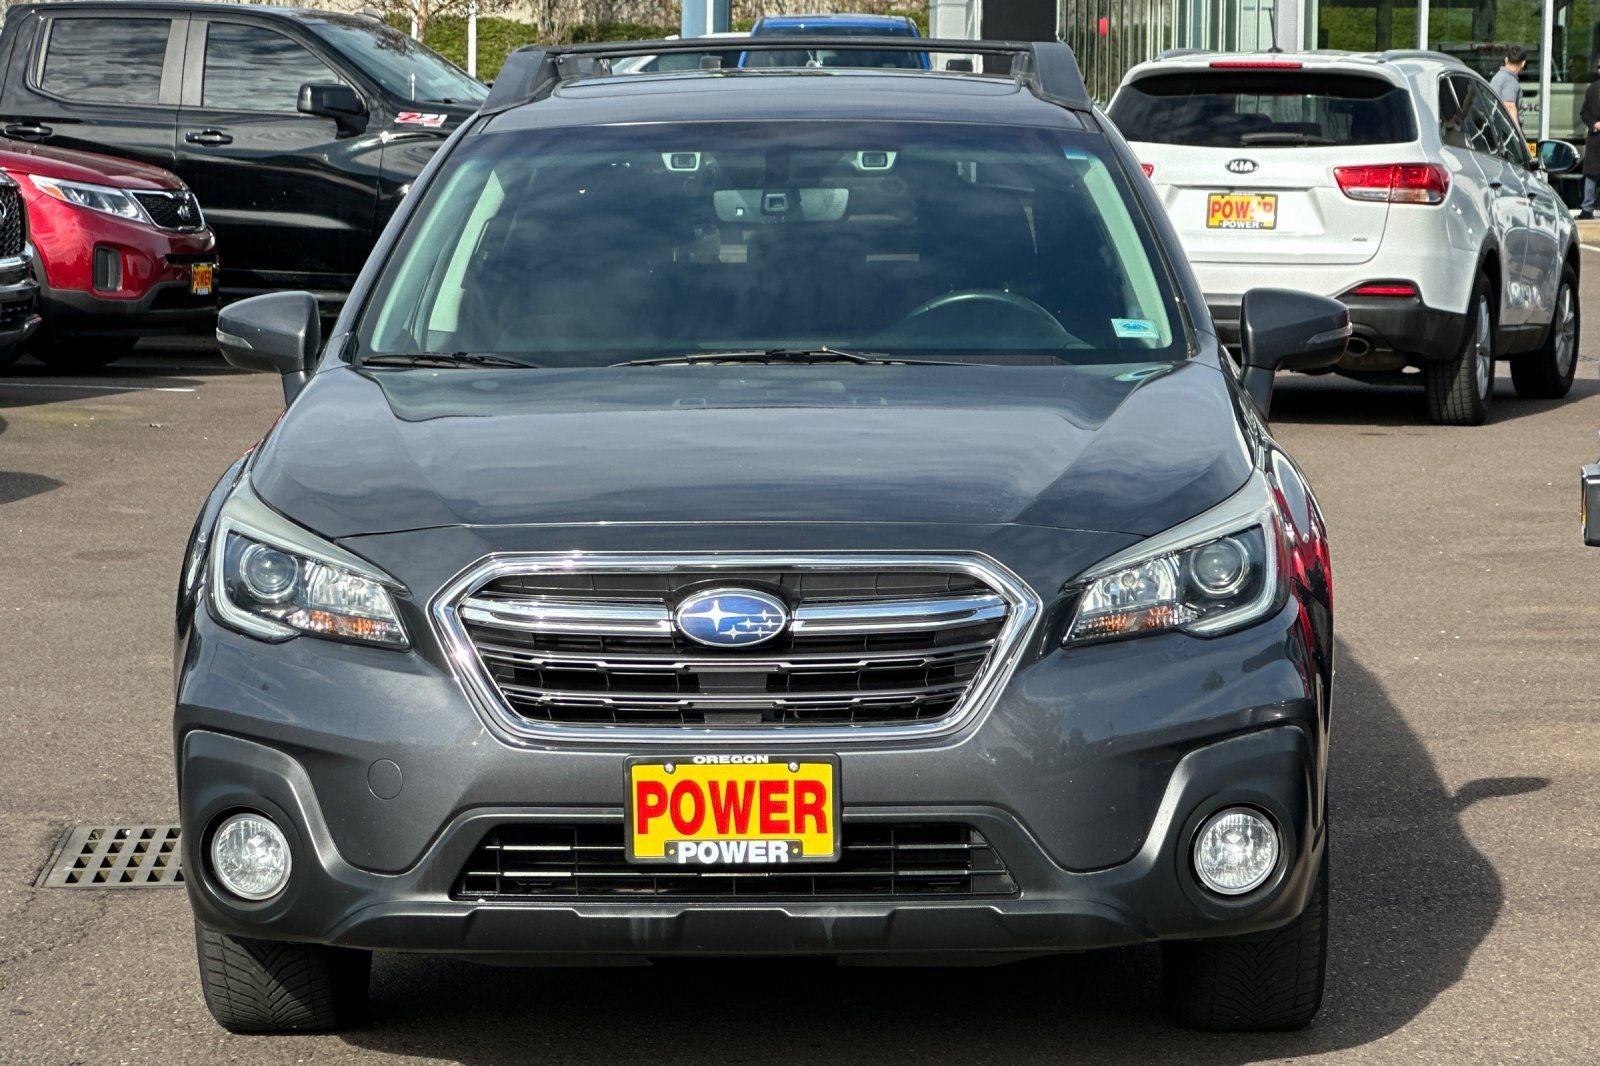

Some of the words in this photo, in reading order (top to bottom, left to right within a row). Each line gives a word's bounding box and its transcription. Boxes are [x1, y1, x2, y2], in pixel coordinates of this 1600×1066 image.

[394, 111, 448, 127] Z71
[1229, 160, 1254, 171] KIA
[1222, 220, 1260, 229] POWER
[692, 754, 769, 764] OREGON
[636, 779, 828, 835] POWER
[677, 840, 789, 864] POWER
